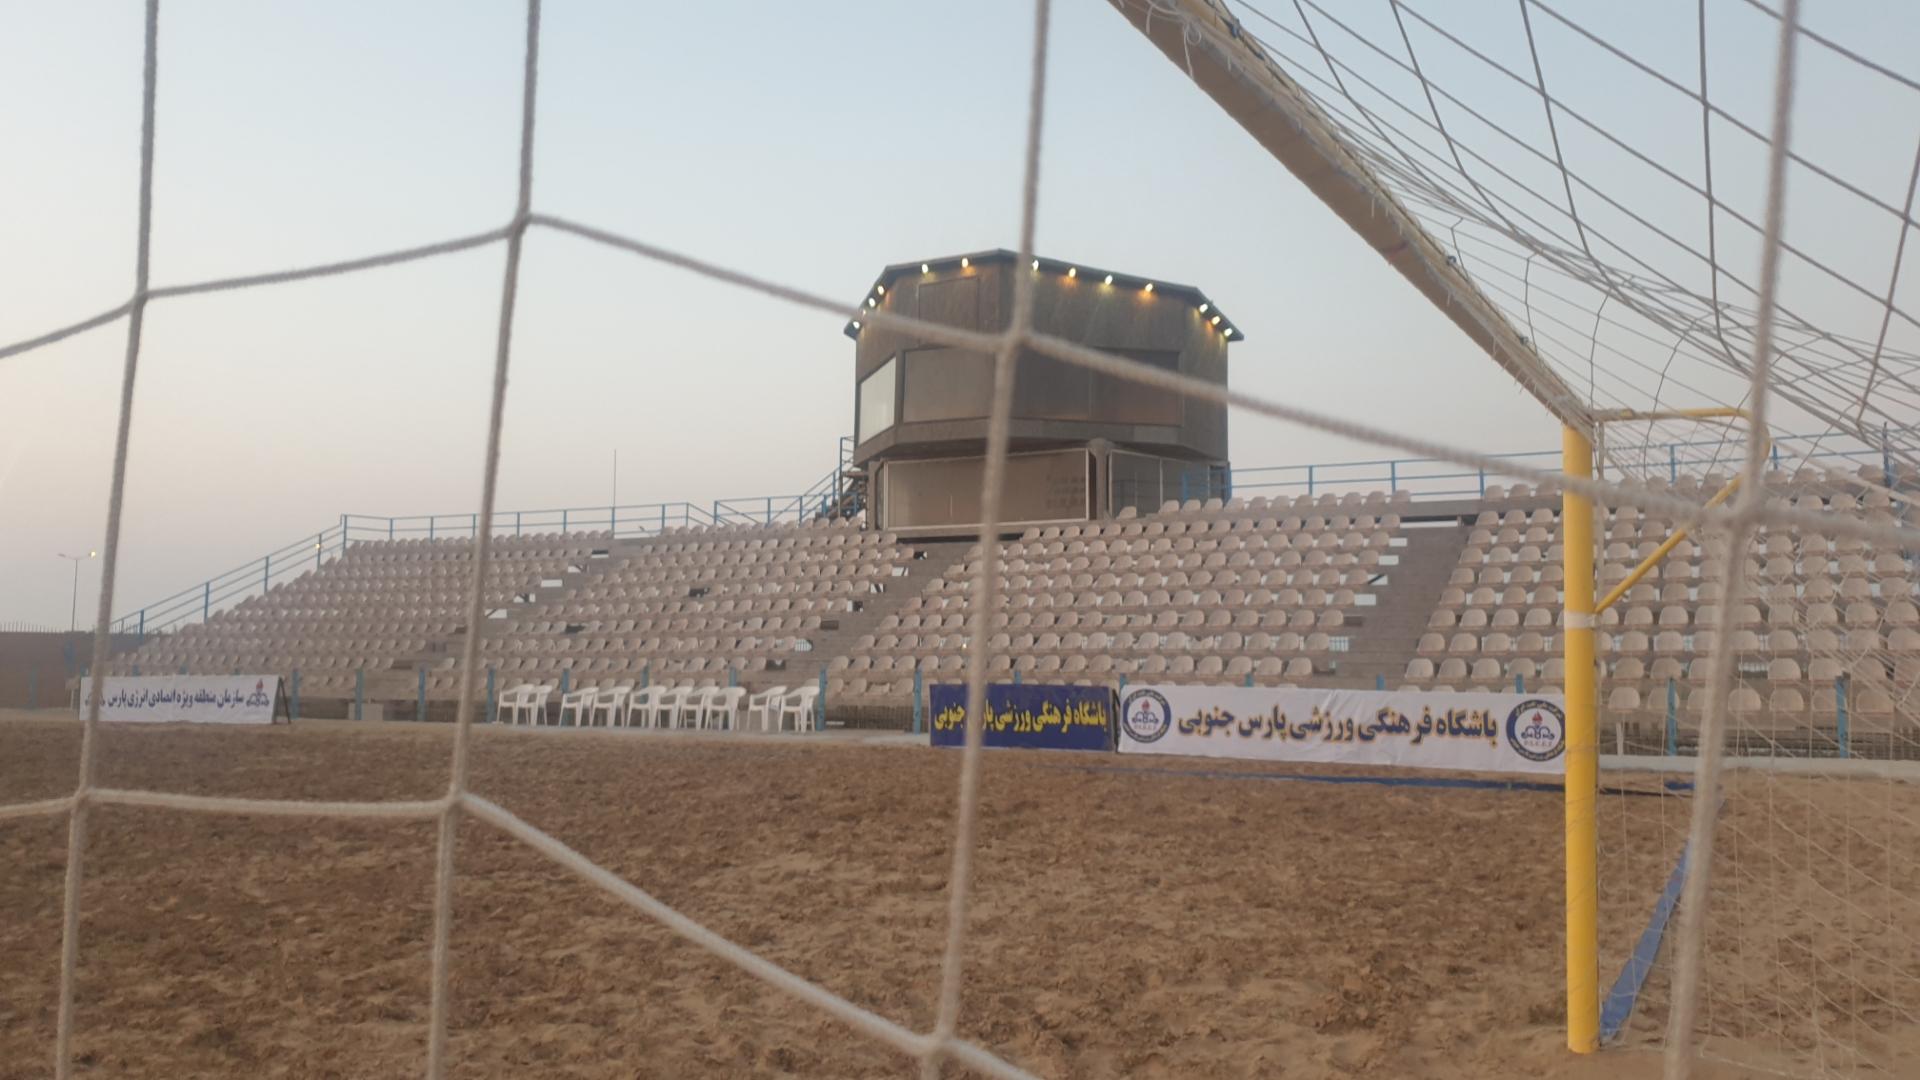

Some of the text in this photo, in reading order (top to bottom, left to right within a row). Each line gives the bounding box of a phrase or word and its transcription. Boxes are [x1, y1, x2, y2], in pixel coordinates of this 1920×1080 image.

[934, 702, 966, 732] جنوبی
[995, 699, 1032, 733] ورزشی
[1032, 698, 1072, 733] فرهنگی
[1073, 700, 1107, 731] باشگاه
[1178, 705, 1235, 737] جنوبی
[1237, 704, 1287, 741] پارس
[1289, 704, 1354, 742] ورزشی
[1357, 705, 1434, 745] فرهنگی
[1436, 708, 1498, 751] باشگاه
